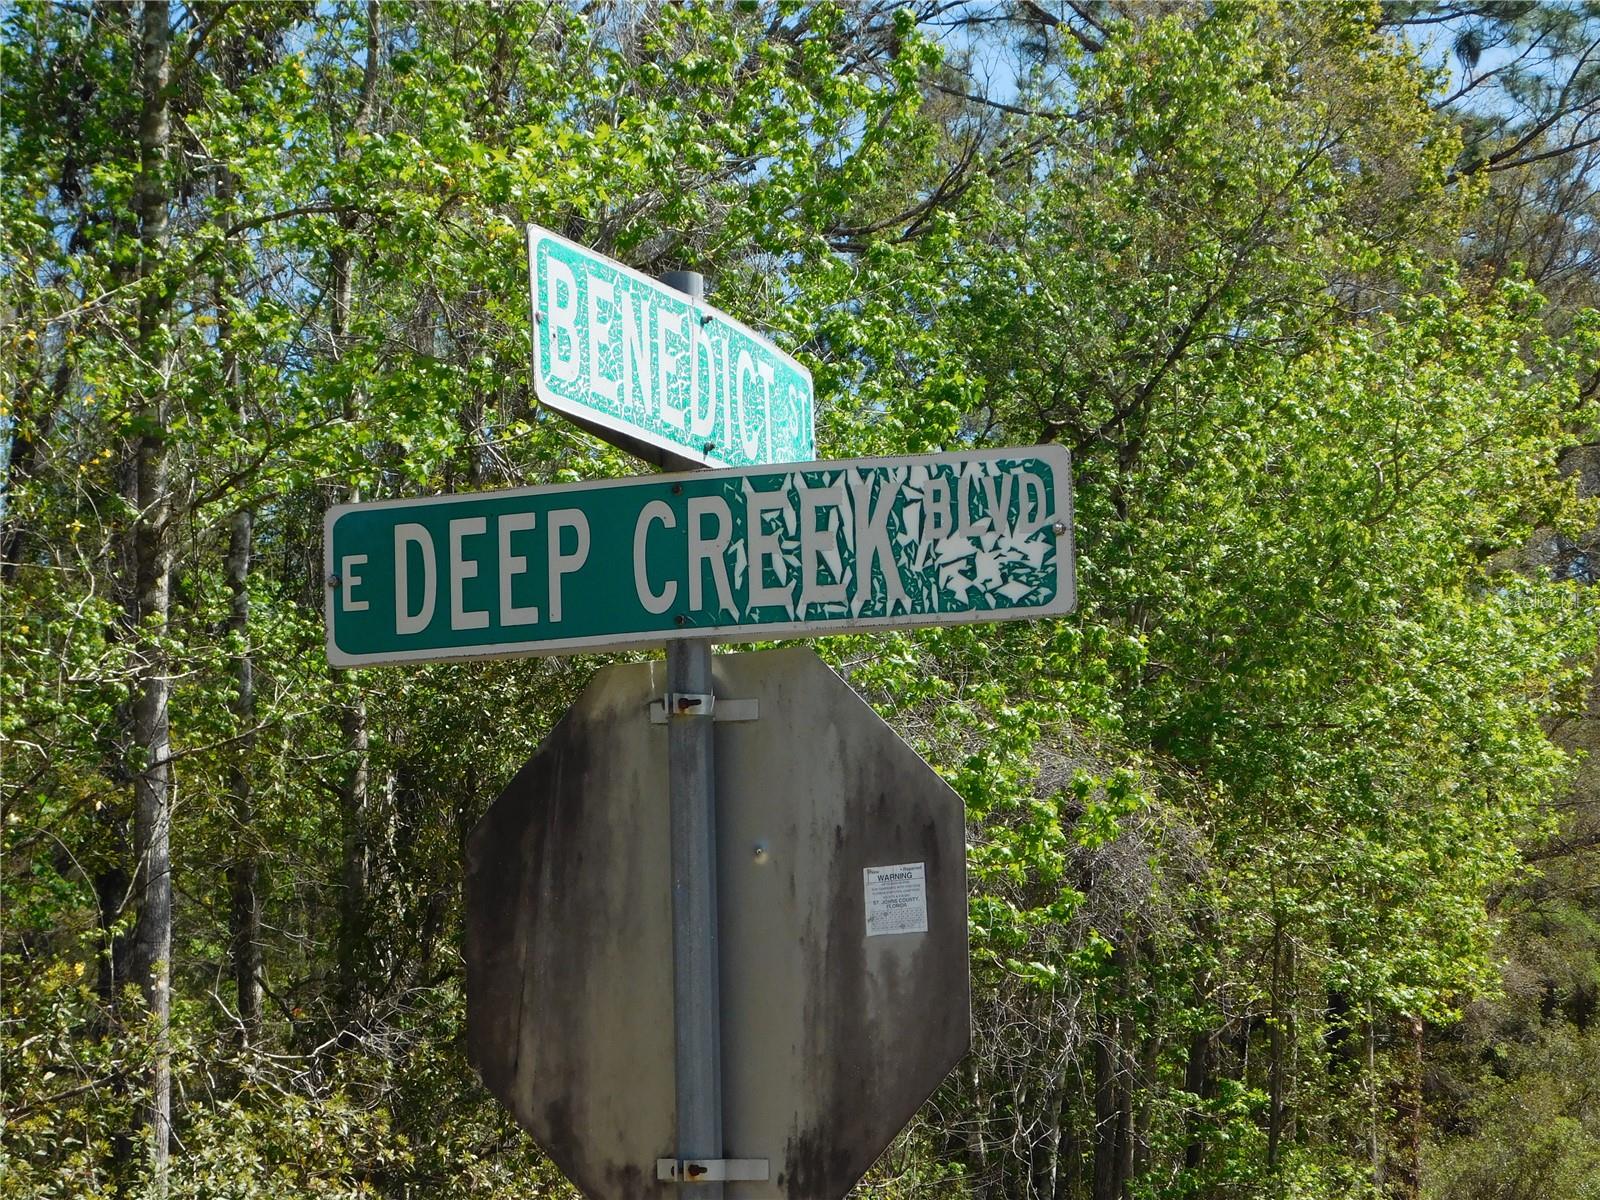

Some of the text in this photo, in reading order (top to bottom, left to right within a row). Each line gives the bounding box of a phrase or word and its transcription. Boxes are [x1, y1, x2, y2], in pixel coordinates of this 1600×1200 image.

[547, 258, 808, 465] BENEDICT ST
[341, 472, 1047, 635] E DEEP CREEK BLVD
[877, 871, 913, 881] WARNING
